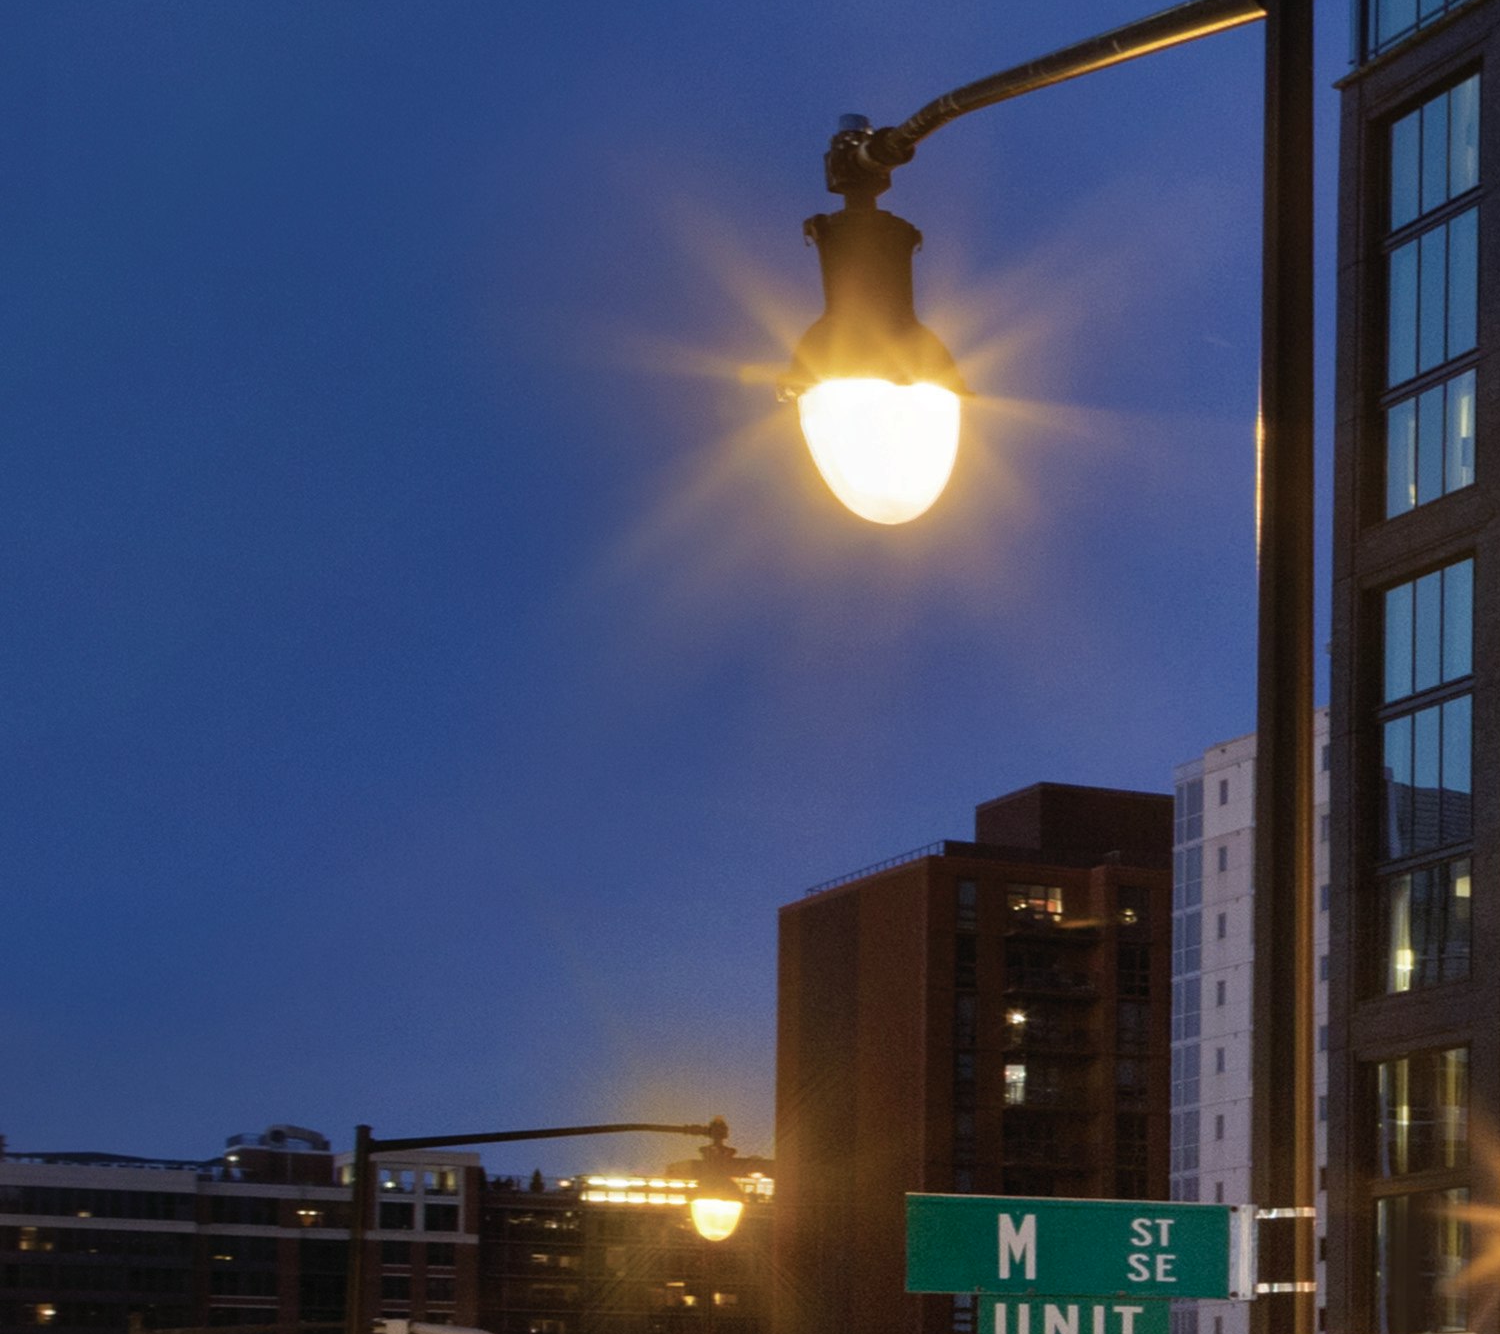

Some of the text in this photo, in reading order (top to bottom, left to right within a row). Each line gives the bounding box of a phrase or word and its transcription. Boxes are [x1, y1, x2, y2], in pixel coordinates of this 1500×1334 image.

[998, 1213, 1175, 1280] M ST
[1127, 1254, 1177, 1282] SE
